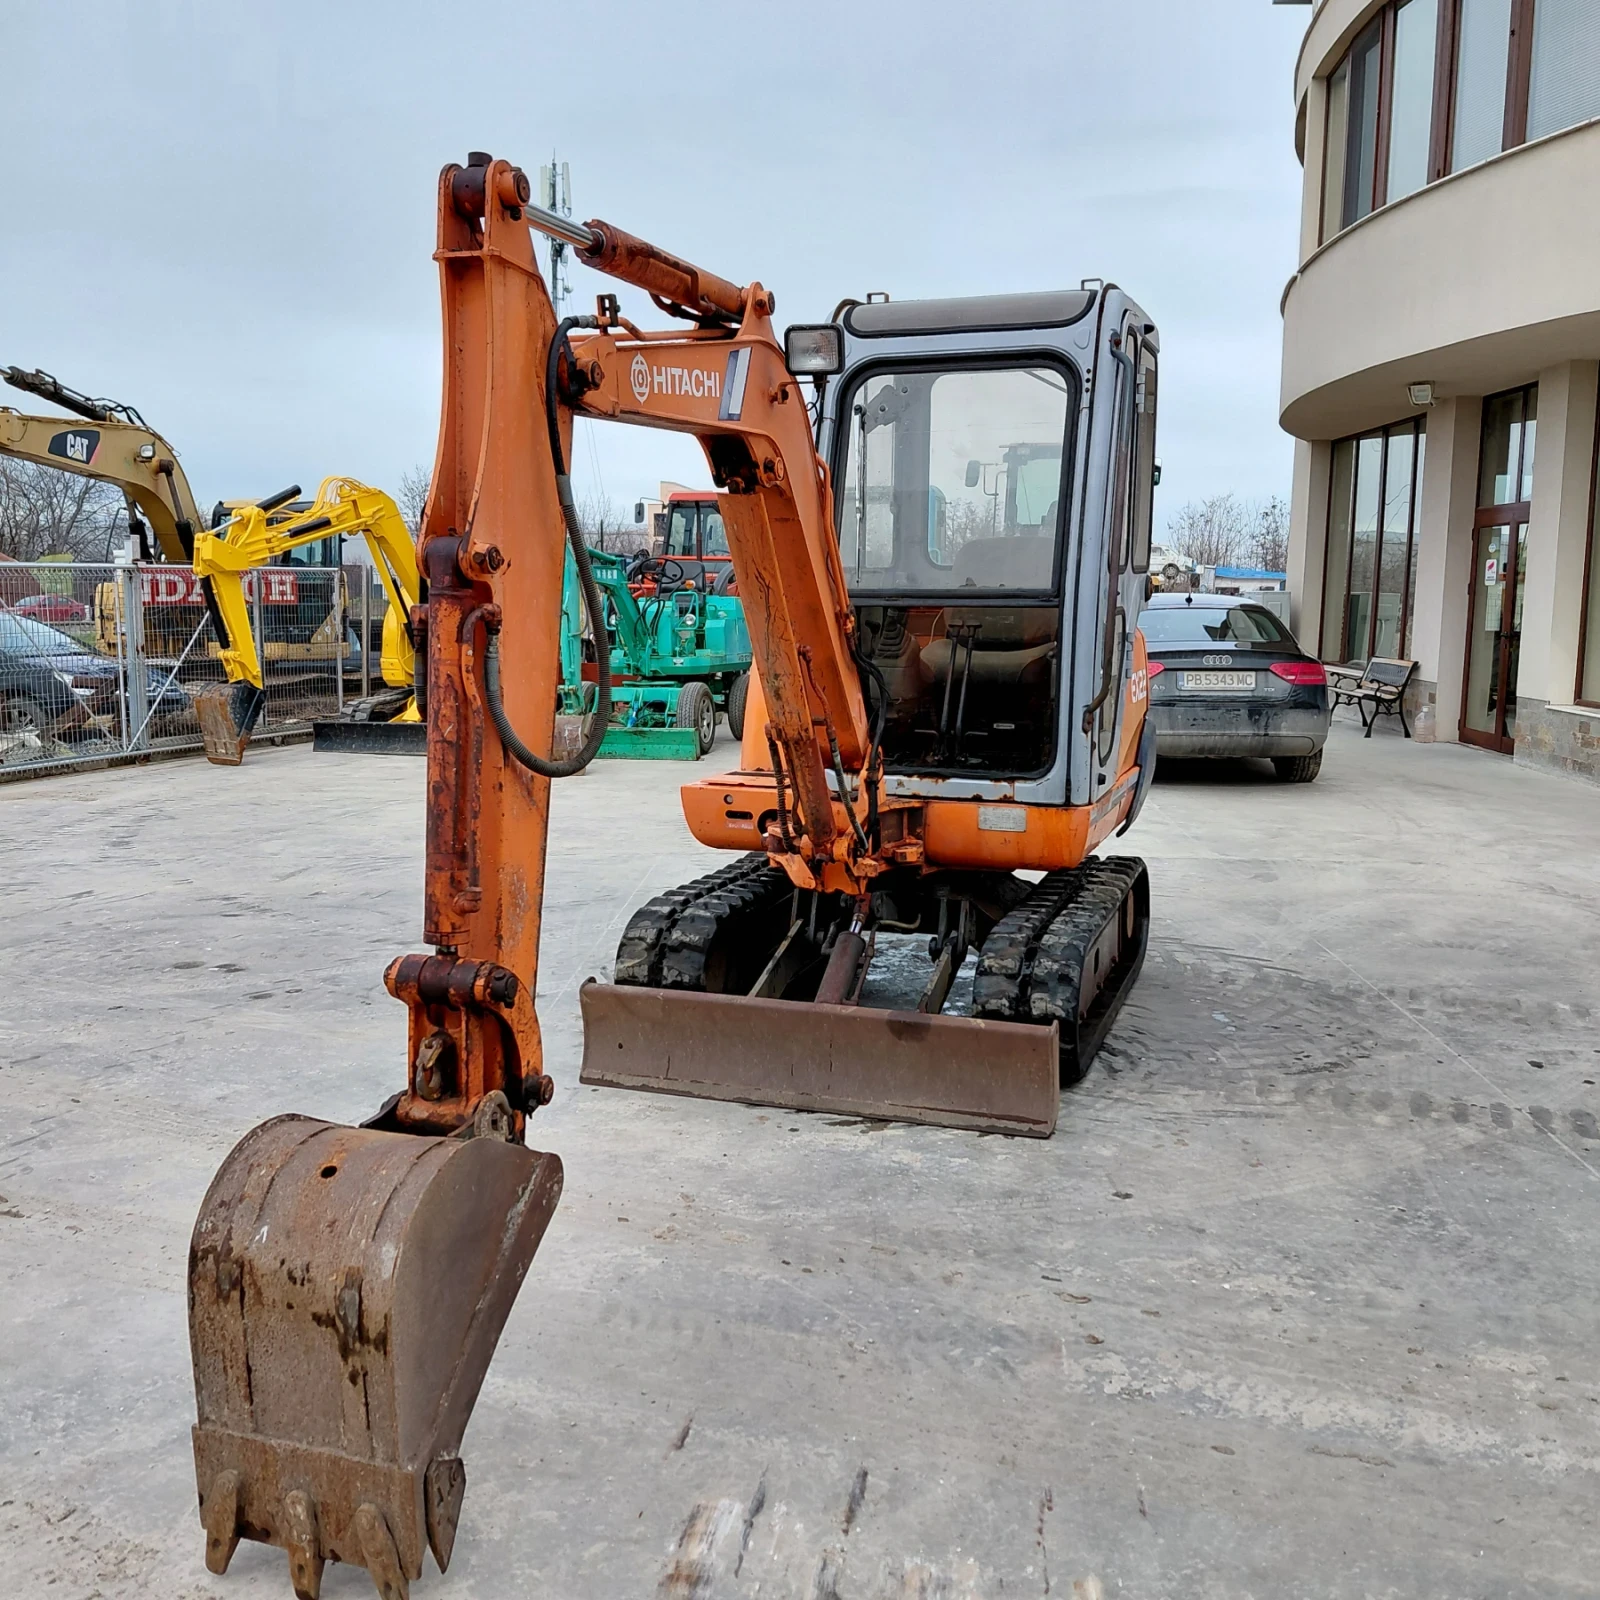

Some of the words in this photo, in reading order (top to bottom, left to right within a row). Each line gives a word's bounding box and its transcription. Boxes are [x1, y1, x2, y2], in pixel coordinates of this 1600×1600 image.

[653, 365, 720, 397] HITACHI
[66, 433, 89, 462] CAT
[1204, 673, 1235, 686] 5343
[1236, 674, 1253, 686] MC
